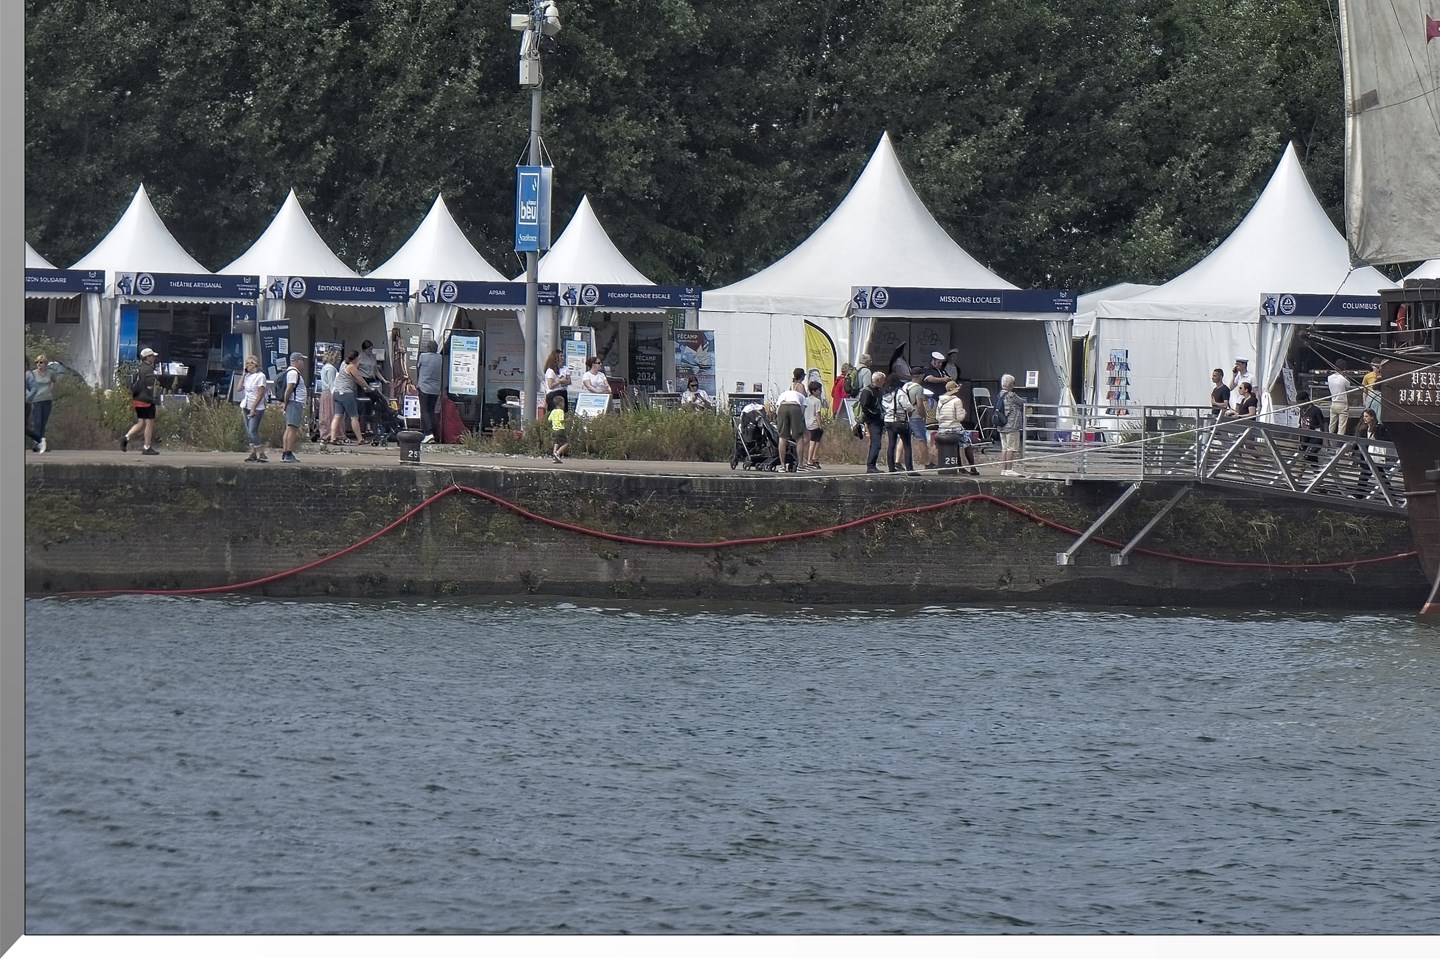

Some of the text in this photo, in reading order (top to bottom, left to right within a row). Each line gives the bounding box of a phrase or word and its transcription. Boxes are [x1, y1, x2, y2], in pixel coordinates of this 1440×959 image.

[317, 284, 341, 292] ÉDITIONS
[607, 291, 629, 299] FÉCAMP
[939, 295, 1001, 304] MISSIONS LOCALES
[1342, 302, 1377, 310] COLUMBUS
[636, 372, 657, 380] 2024
[1399, 389, 1433, 406] VILA
